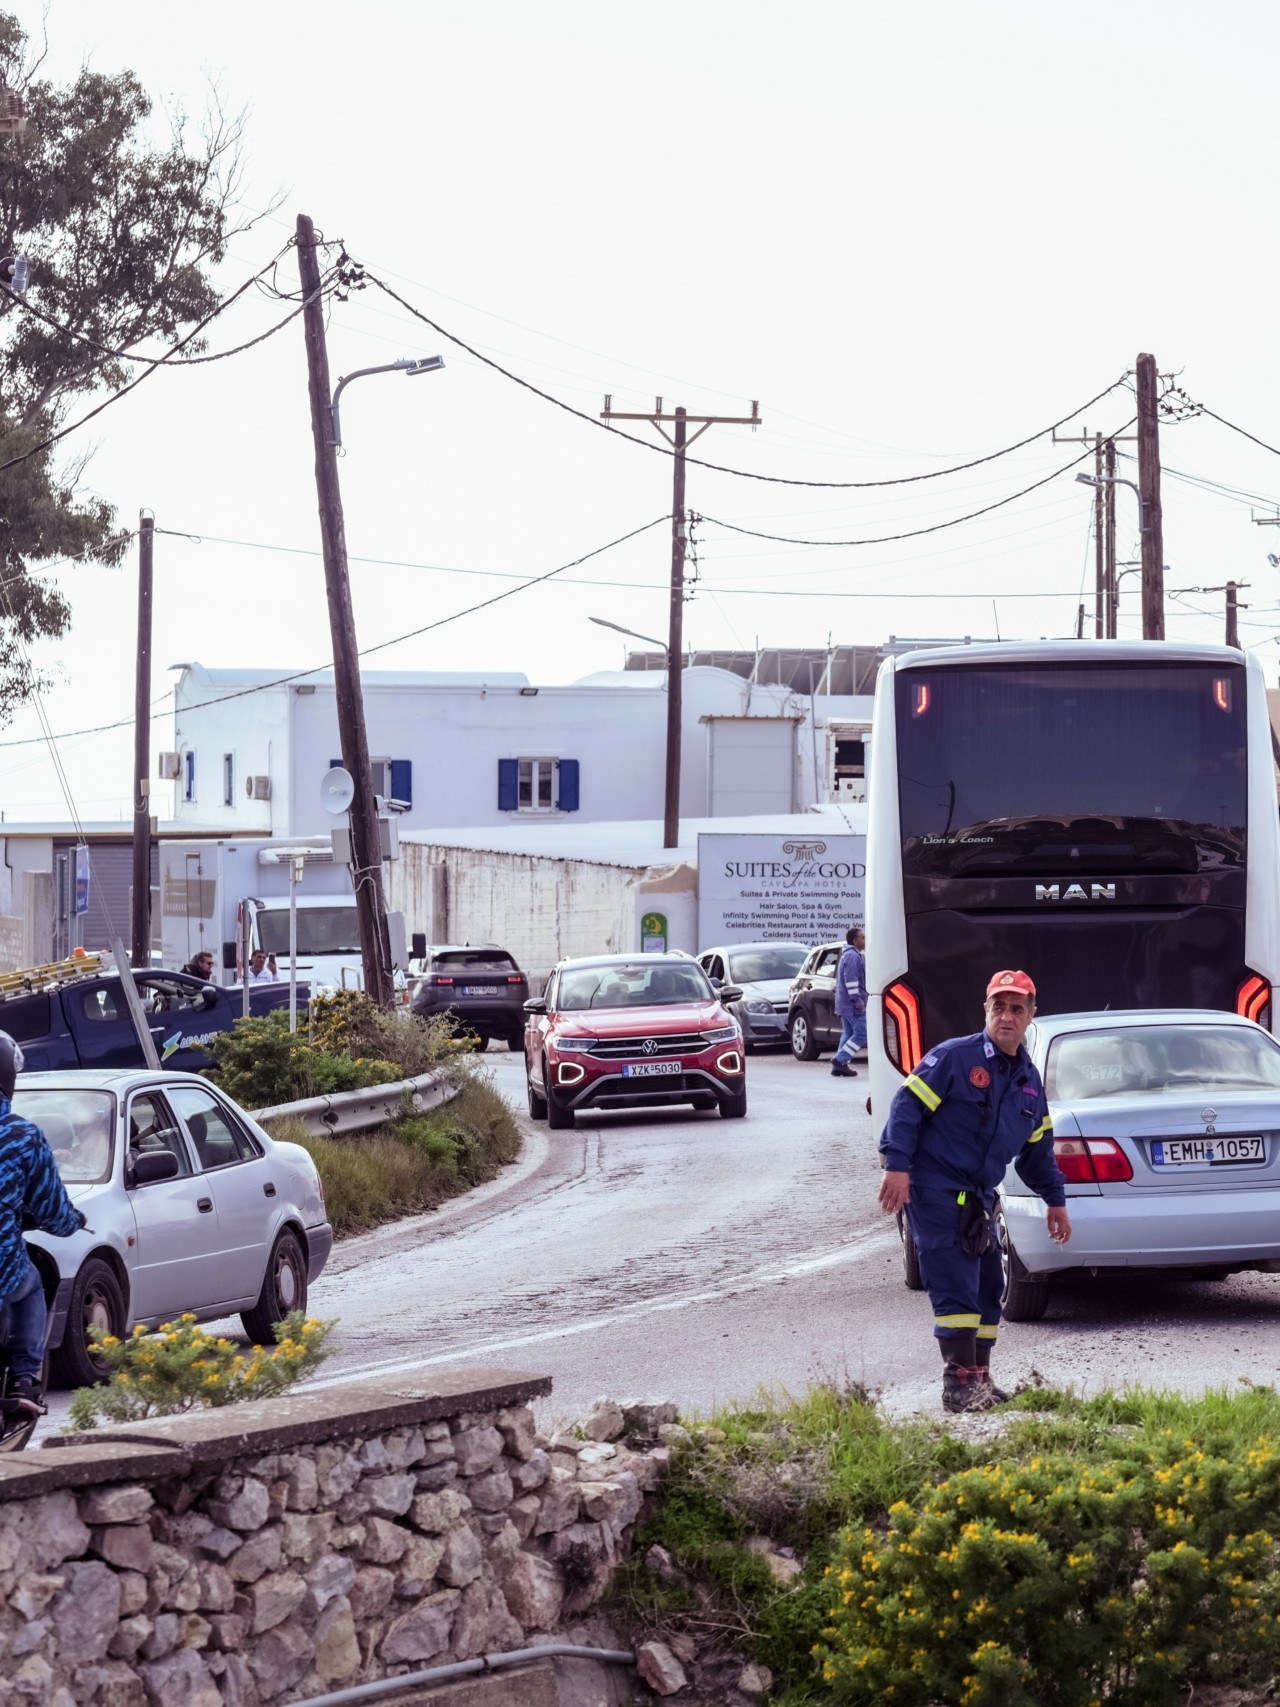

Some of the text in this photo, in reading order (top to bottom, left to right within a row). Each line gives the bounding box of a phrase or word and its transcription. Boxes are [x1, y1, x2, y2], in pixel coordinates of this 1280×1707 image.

[923, 836, 955, 844] Lion's
[724, 862, 791, 878] SUITES
[785, 862, 809, 888] of
[804, 862, 819, 878] the
[800, 891, 839, 899] Swimming
[1035, 883, 1116, 900] MAN
[777, 903, 799, 911] Salon,
[801, 903, 816, 911] Spa
[824, 903, 842, 911] Gym
[723, 912, 749, 920] Infinity
[751, 912, 790, 920] Swimming
[817, 912, 831, 920] Sky
[817, 922, 850, 930] Wedding
